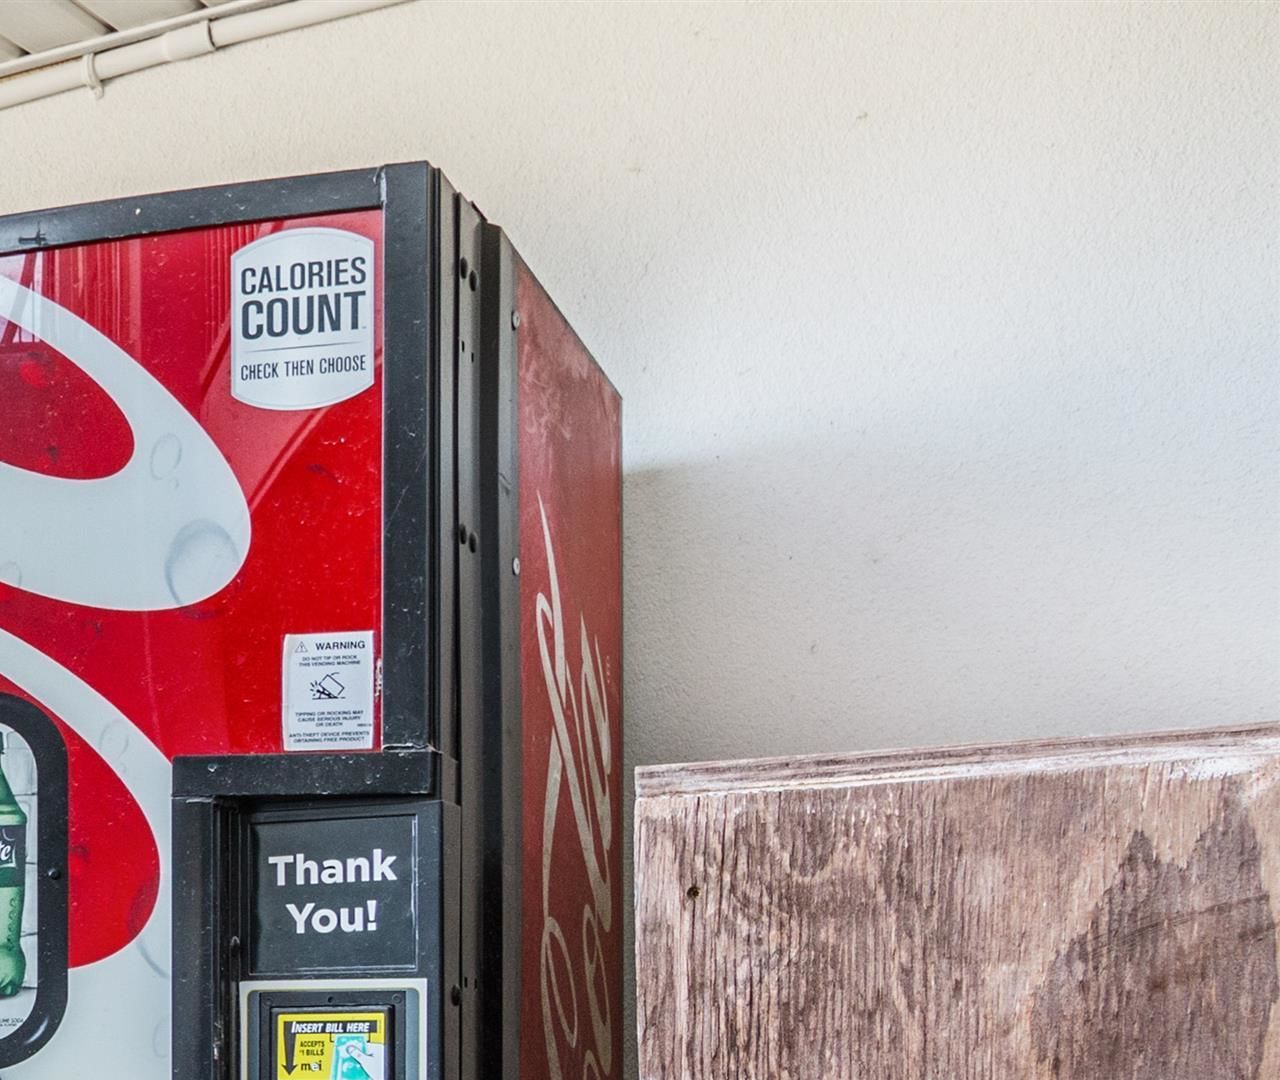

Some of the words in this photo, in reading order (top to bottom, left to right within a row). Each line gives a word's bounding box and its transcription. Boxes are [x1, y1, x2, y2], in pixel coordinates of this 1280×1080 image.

[240, 256, 366, 296] CALORIES
[241, 290, 366, 340] COUNT
[240, 361, 279, 382] CHECK
[284, 359, 314, 377] THEN
[319, 354, 366, 375] CHOOSE
[315, 640, 366, 651] WARNING
[268, 848, 397, 886] Thank
[285, 900, 377, 934] You!
[291, 1021, 324, 1033] INSERT
[325, 1022, 345, 1032] BILL
[346, 1022, 370, 1032] HERE
[301, 1060, 322, 1071] mei
